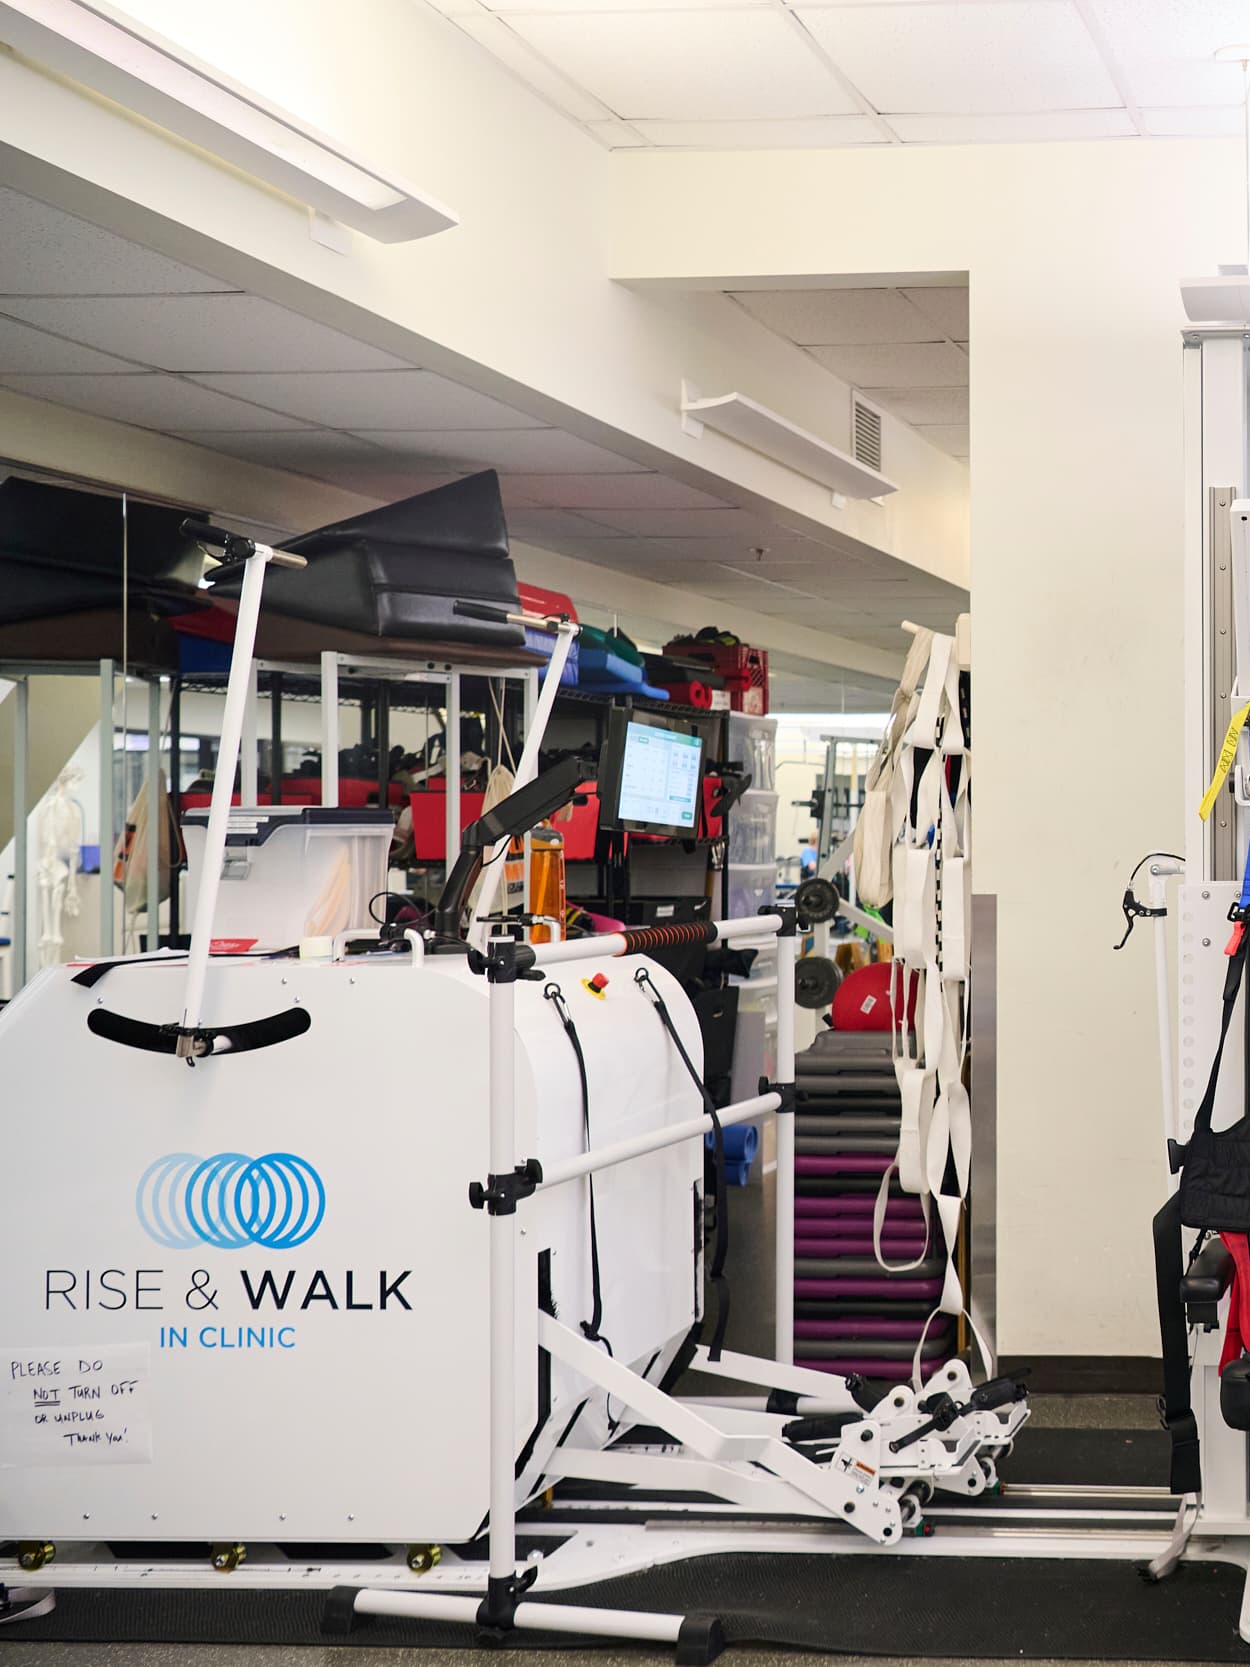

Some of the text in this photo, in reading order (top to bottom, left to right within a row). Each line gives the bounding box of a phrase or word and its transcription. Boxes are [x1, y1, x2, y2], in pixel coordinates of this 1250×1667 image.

[46, 1269, 412, 1311] RISE & WALK
[160, 1327, 296, 1348] IN CLINIC
[11, 1360, 103, 1380] PLEASE DO
[33, 1380, 139, 1400] NOT TURN OFF
[34, 1409, 105, 1424] OR UNPLUG
